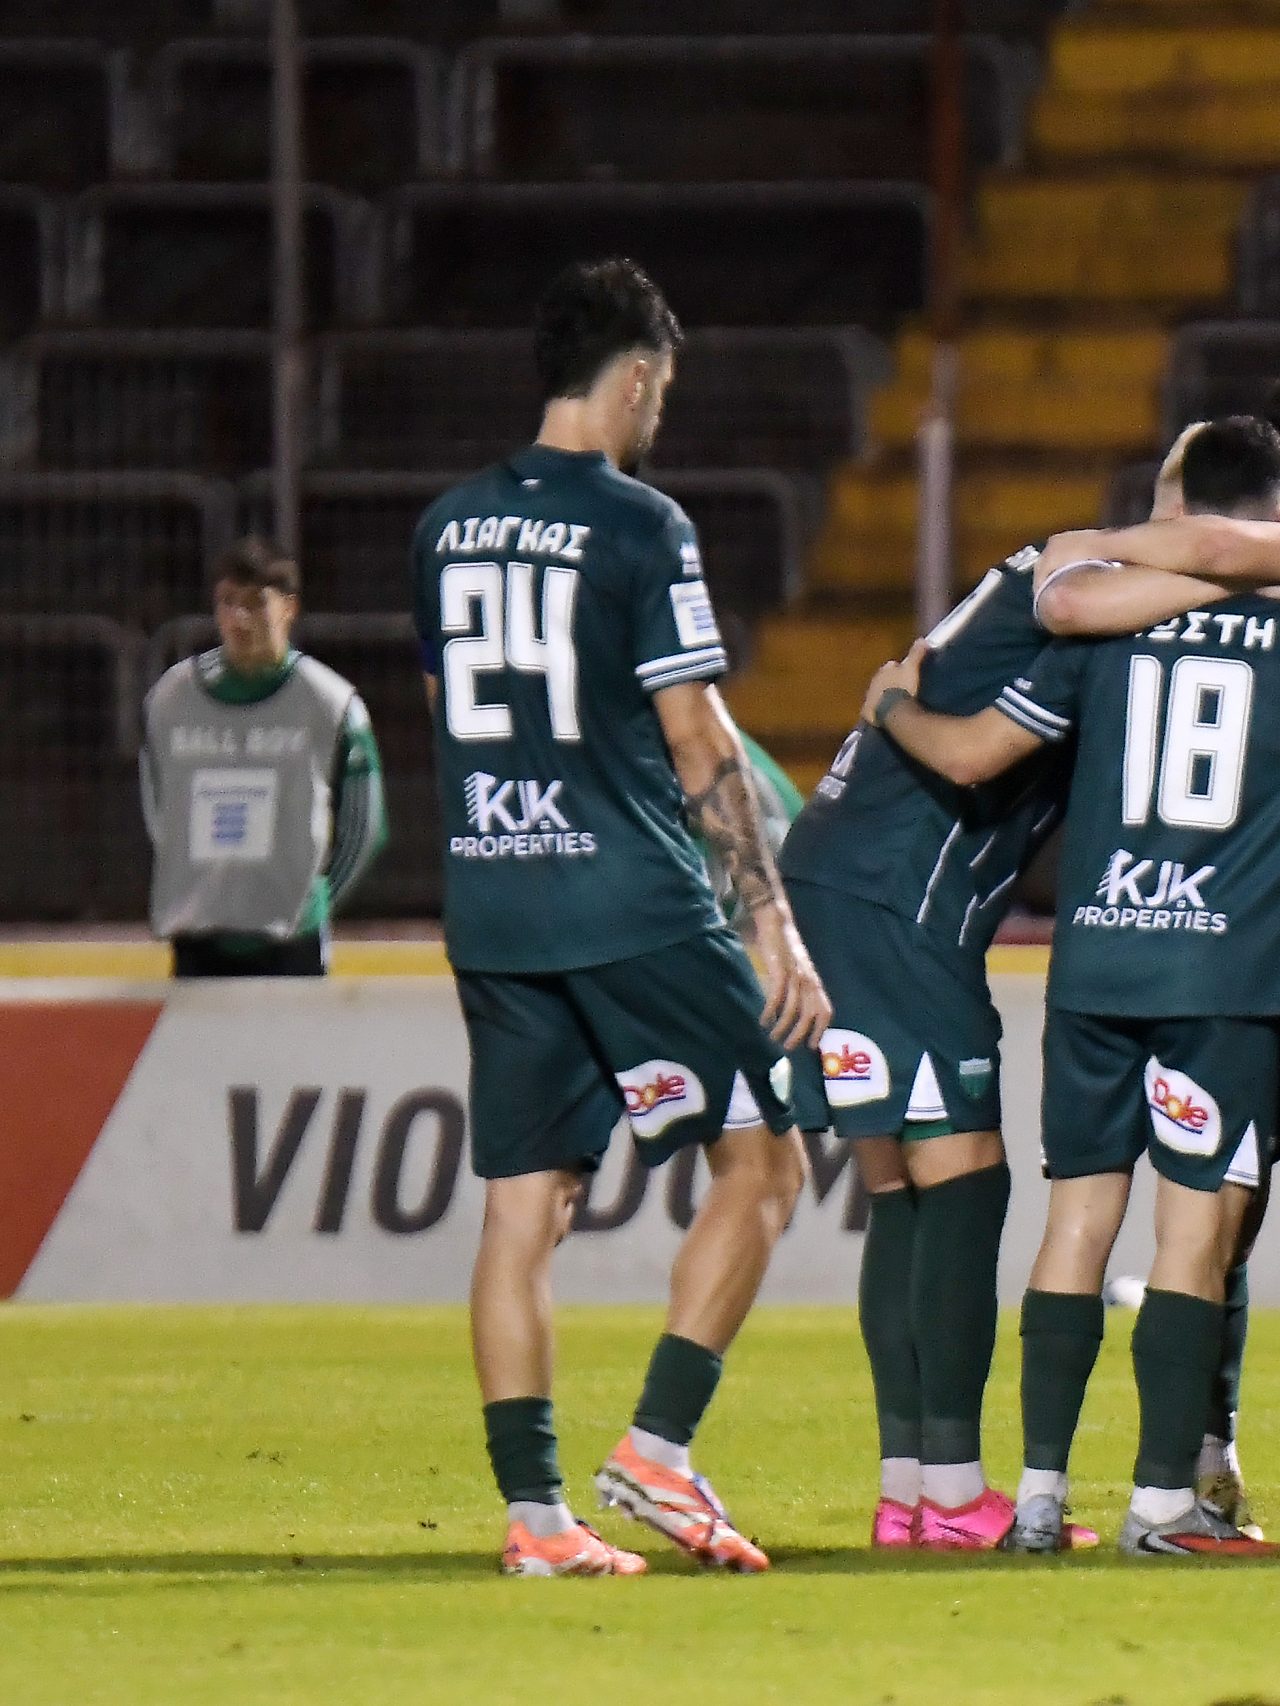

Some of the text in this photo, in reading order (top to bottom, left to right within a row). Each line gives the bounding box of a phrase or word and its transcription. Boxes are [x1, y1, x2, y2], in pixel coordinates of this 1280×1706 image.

[440, 561, 582, 742] 24
[1122, 654, 1256, 829] 18
[463, 771, 571, 833] KJK
[449, 832, 598, 858] PROPERTIES
[1095, 848, 1217, 909] KJK
[1072, 904, 1229, 935] PROPERTIES
[623, 1072, 686, 1112] Dole
[1151, 1077, 1209, 1128] Dole
